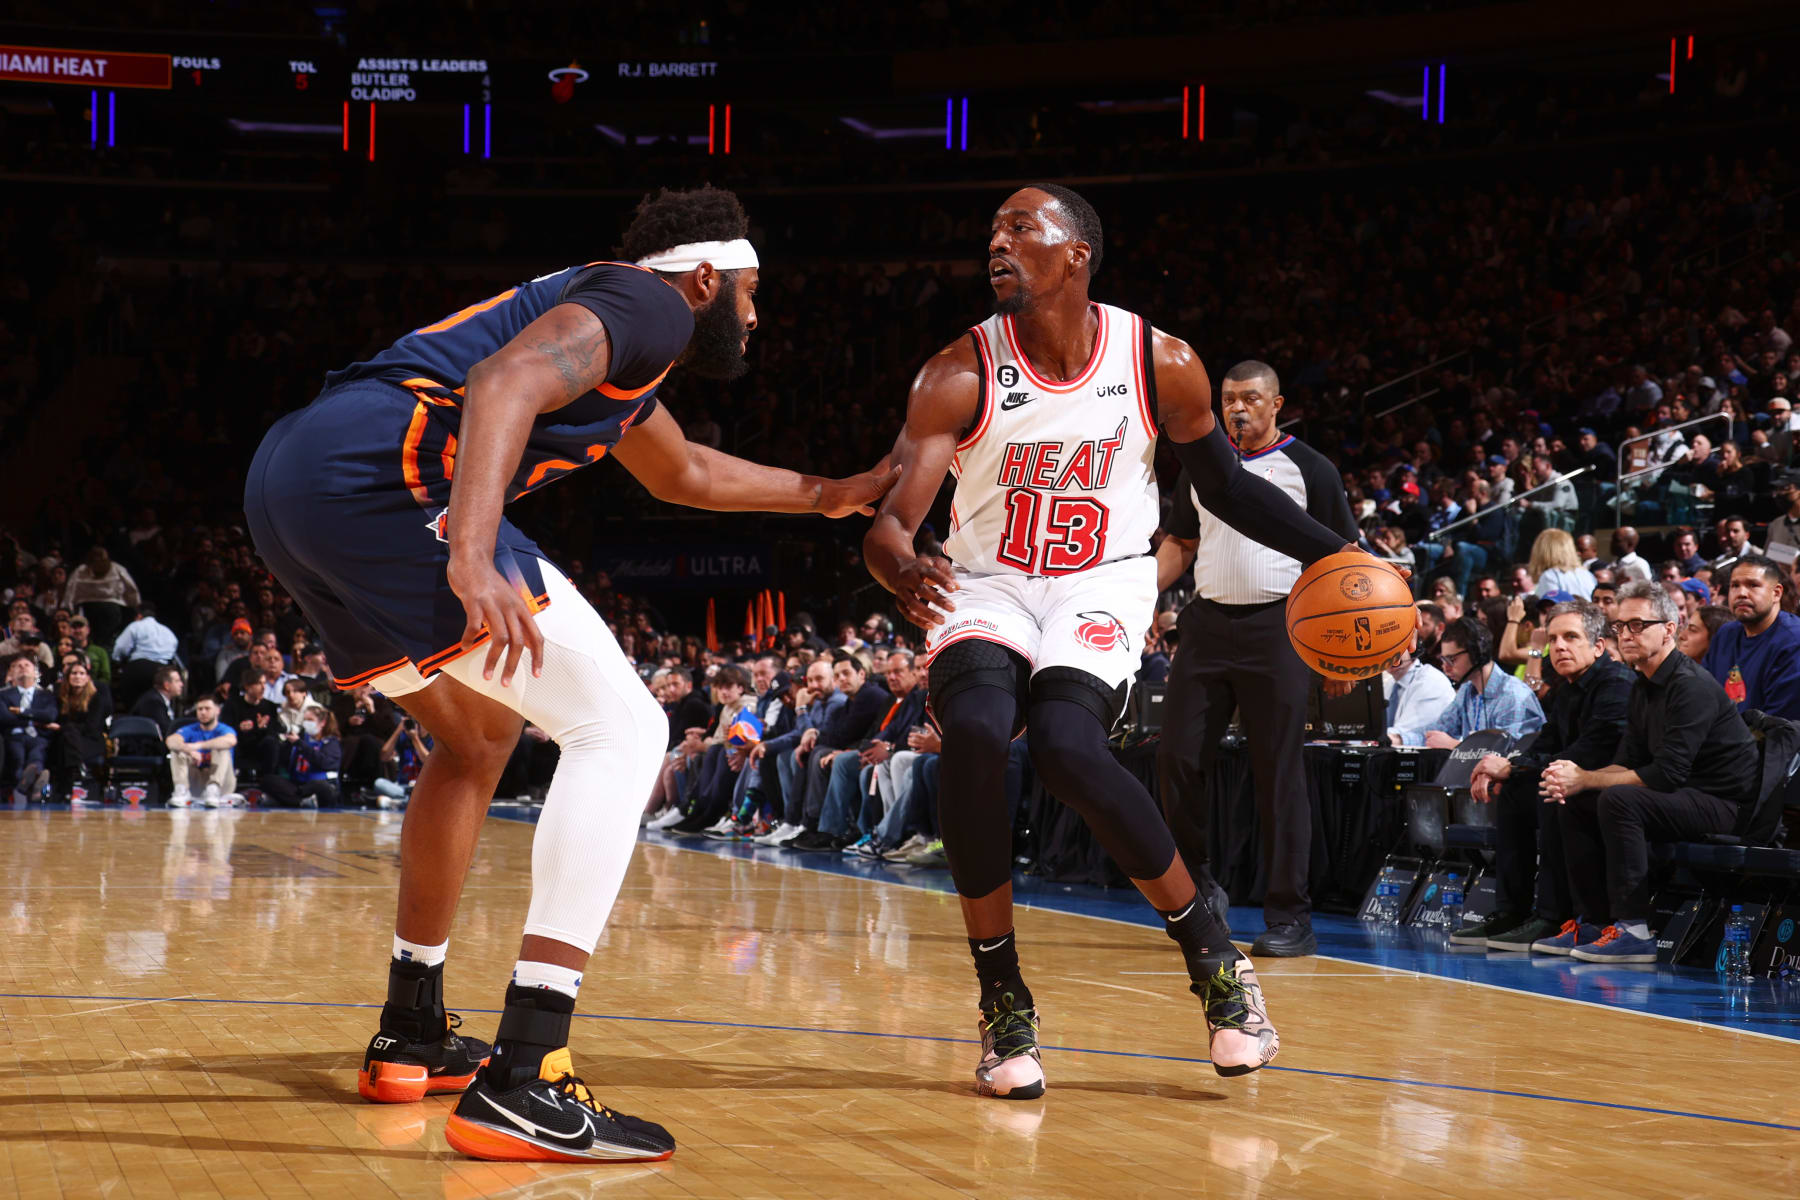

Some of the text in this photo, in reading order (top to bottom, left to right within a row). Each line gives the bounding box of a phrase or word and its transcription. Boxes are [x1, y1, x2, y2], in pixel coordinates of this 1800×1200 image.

[0, 53, 109, 78] IAMI HEAT
[172, 56, 221, 70] FOULS
[289, 60, 318, 74] TOL
[357, 58, 489, 73] ASSISTS LEADERS
[648, 61, 719, 78] BARRETT
[351, 72, 410, 87] BUTLER
[350, 87, 417, 102] OLADIPO
[1000, 368, 1015, 386] 6
[1006, 391, 1030, 404] NIKE
[997, 416, 1129, 491] HEAT
[996, 487, 1110, 577] 13
[690, 556, 762, 575] ULTRA
[373, 1036, 397, 1051] GT
